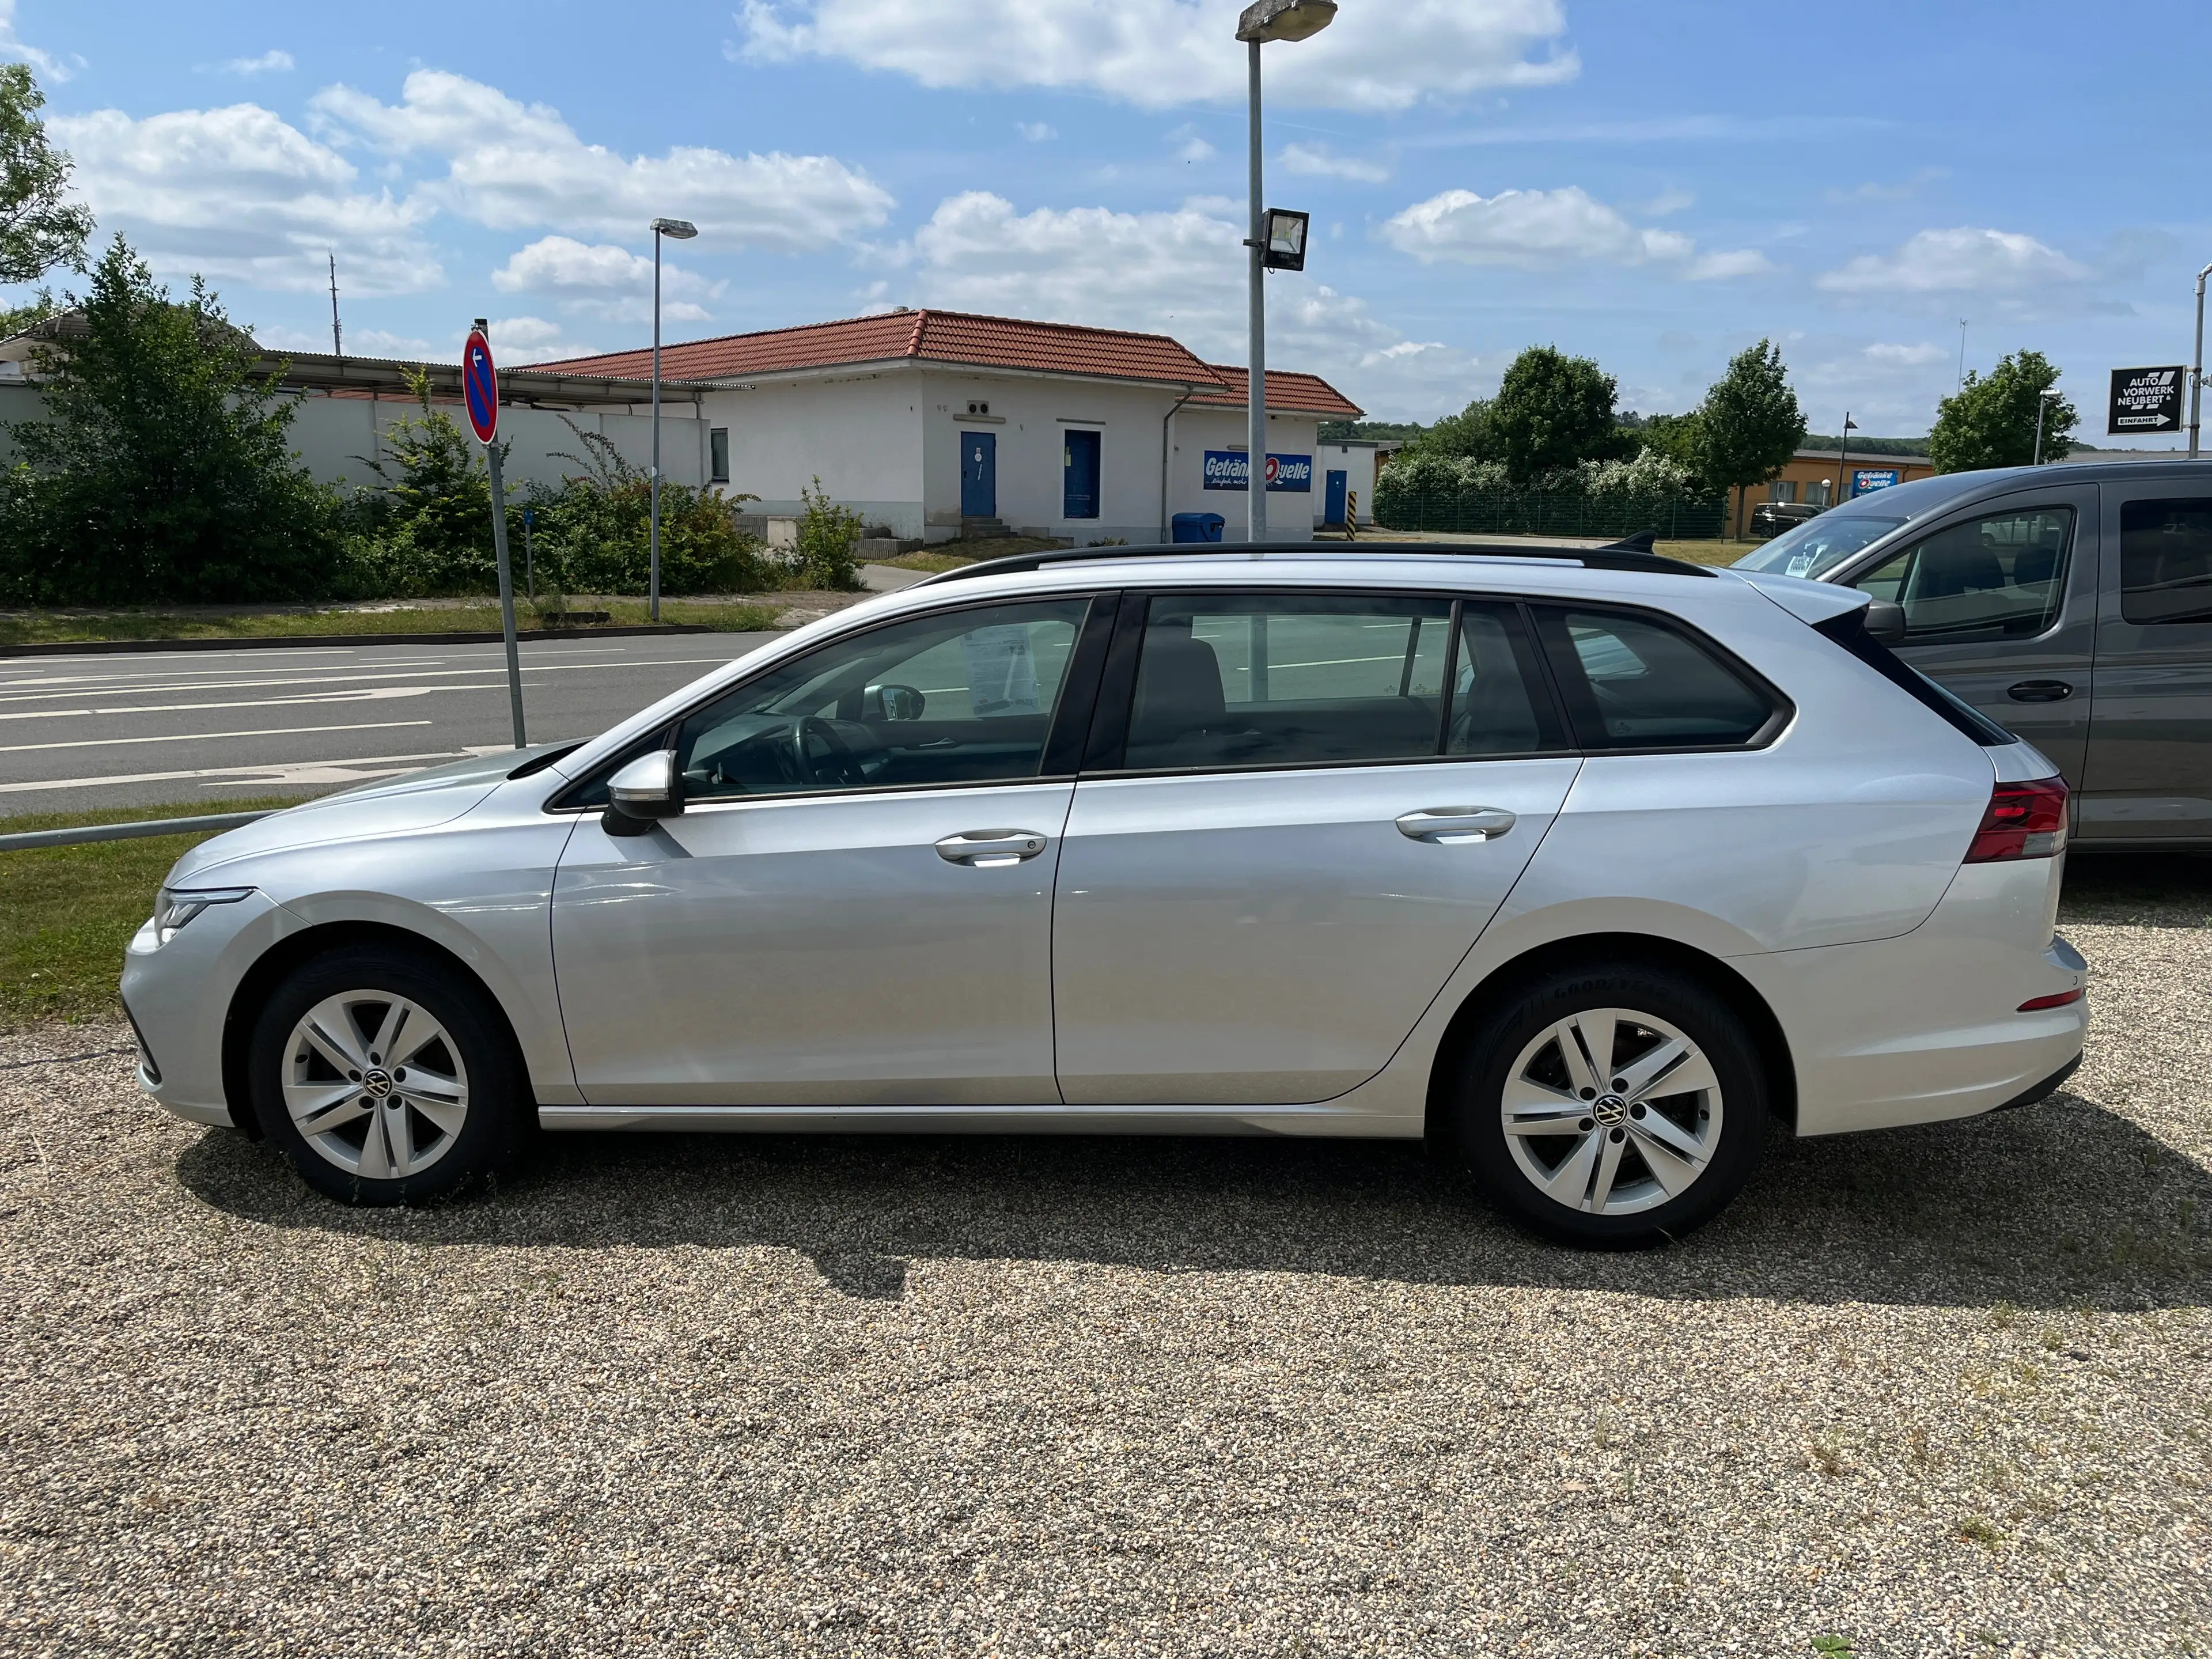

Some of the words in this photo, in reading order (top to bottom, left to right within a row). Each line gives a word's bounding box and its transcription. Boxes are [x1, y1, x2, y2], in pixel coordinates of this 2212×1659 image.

[2130, 377, 2159, 387] AUTO
[2123, 385, 2175, 396] VORWERK
[2118, 395, 2164, 406] NEUBERT
[1206, 457, 1249, 477] Geträn
[1555, 978, 1671, 1001] GOODYEAR
